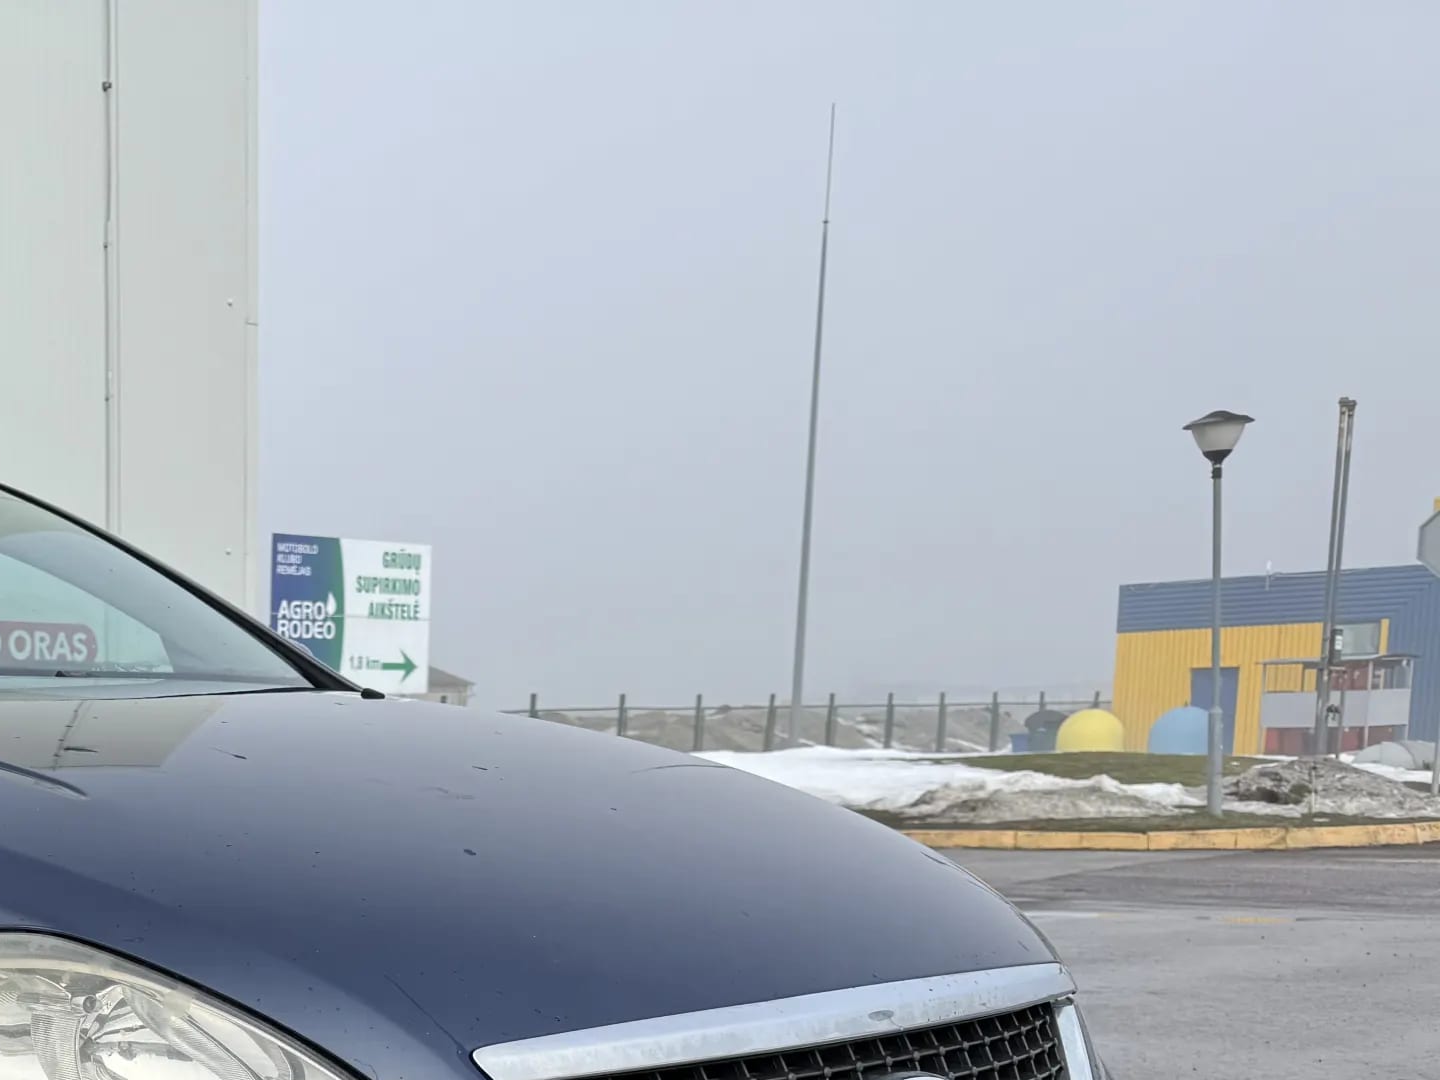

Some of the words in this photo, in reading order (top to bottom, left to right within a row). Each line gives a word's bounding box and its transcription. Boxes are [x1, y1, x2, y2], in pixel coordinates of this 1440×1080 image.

[356, 575, 421, 596] SUPIRKIMO
[278, 600, 325, 620] AGRO
[278, 620, 336, 640] RODEO
[9, 630, 88, 662] ORAS
